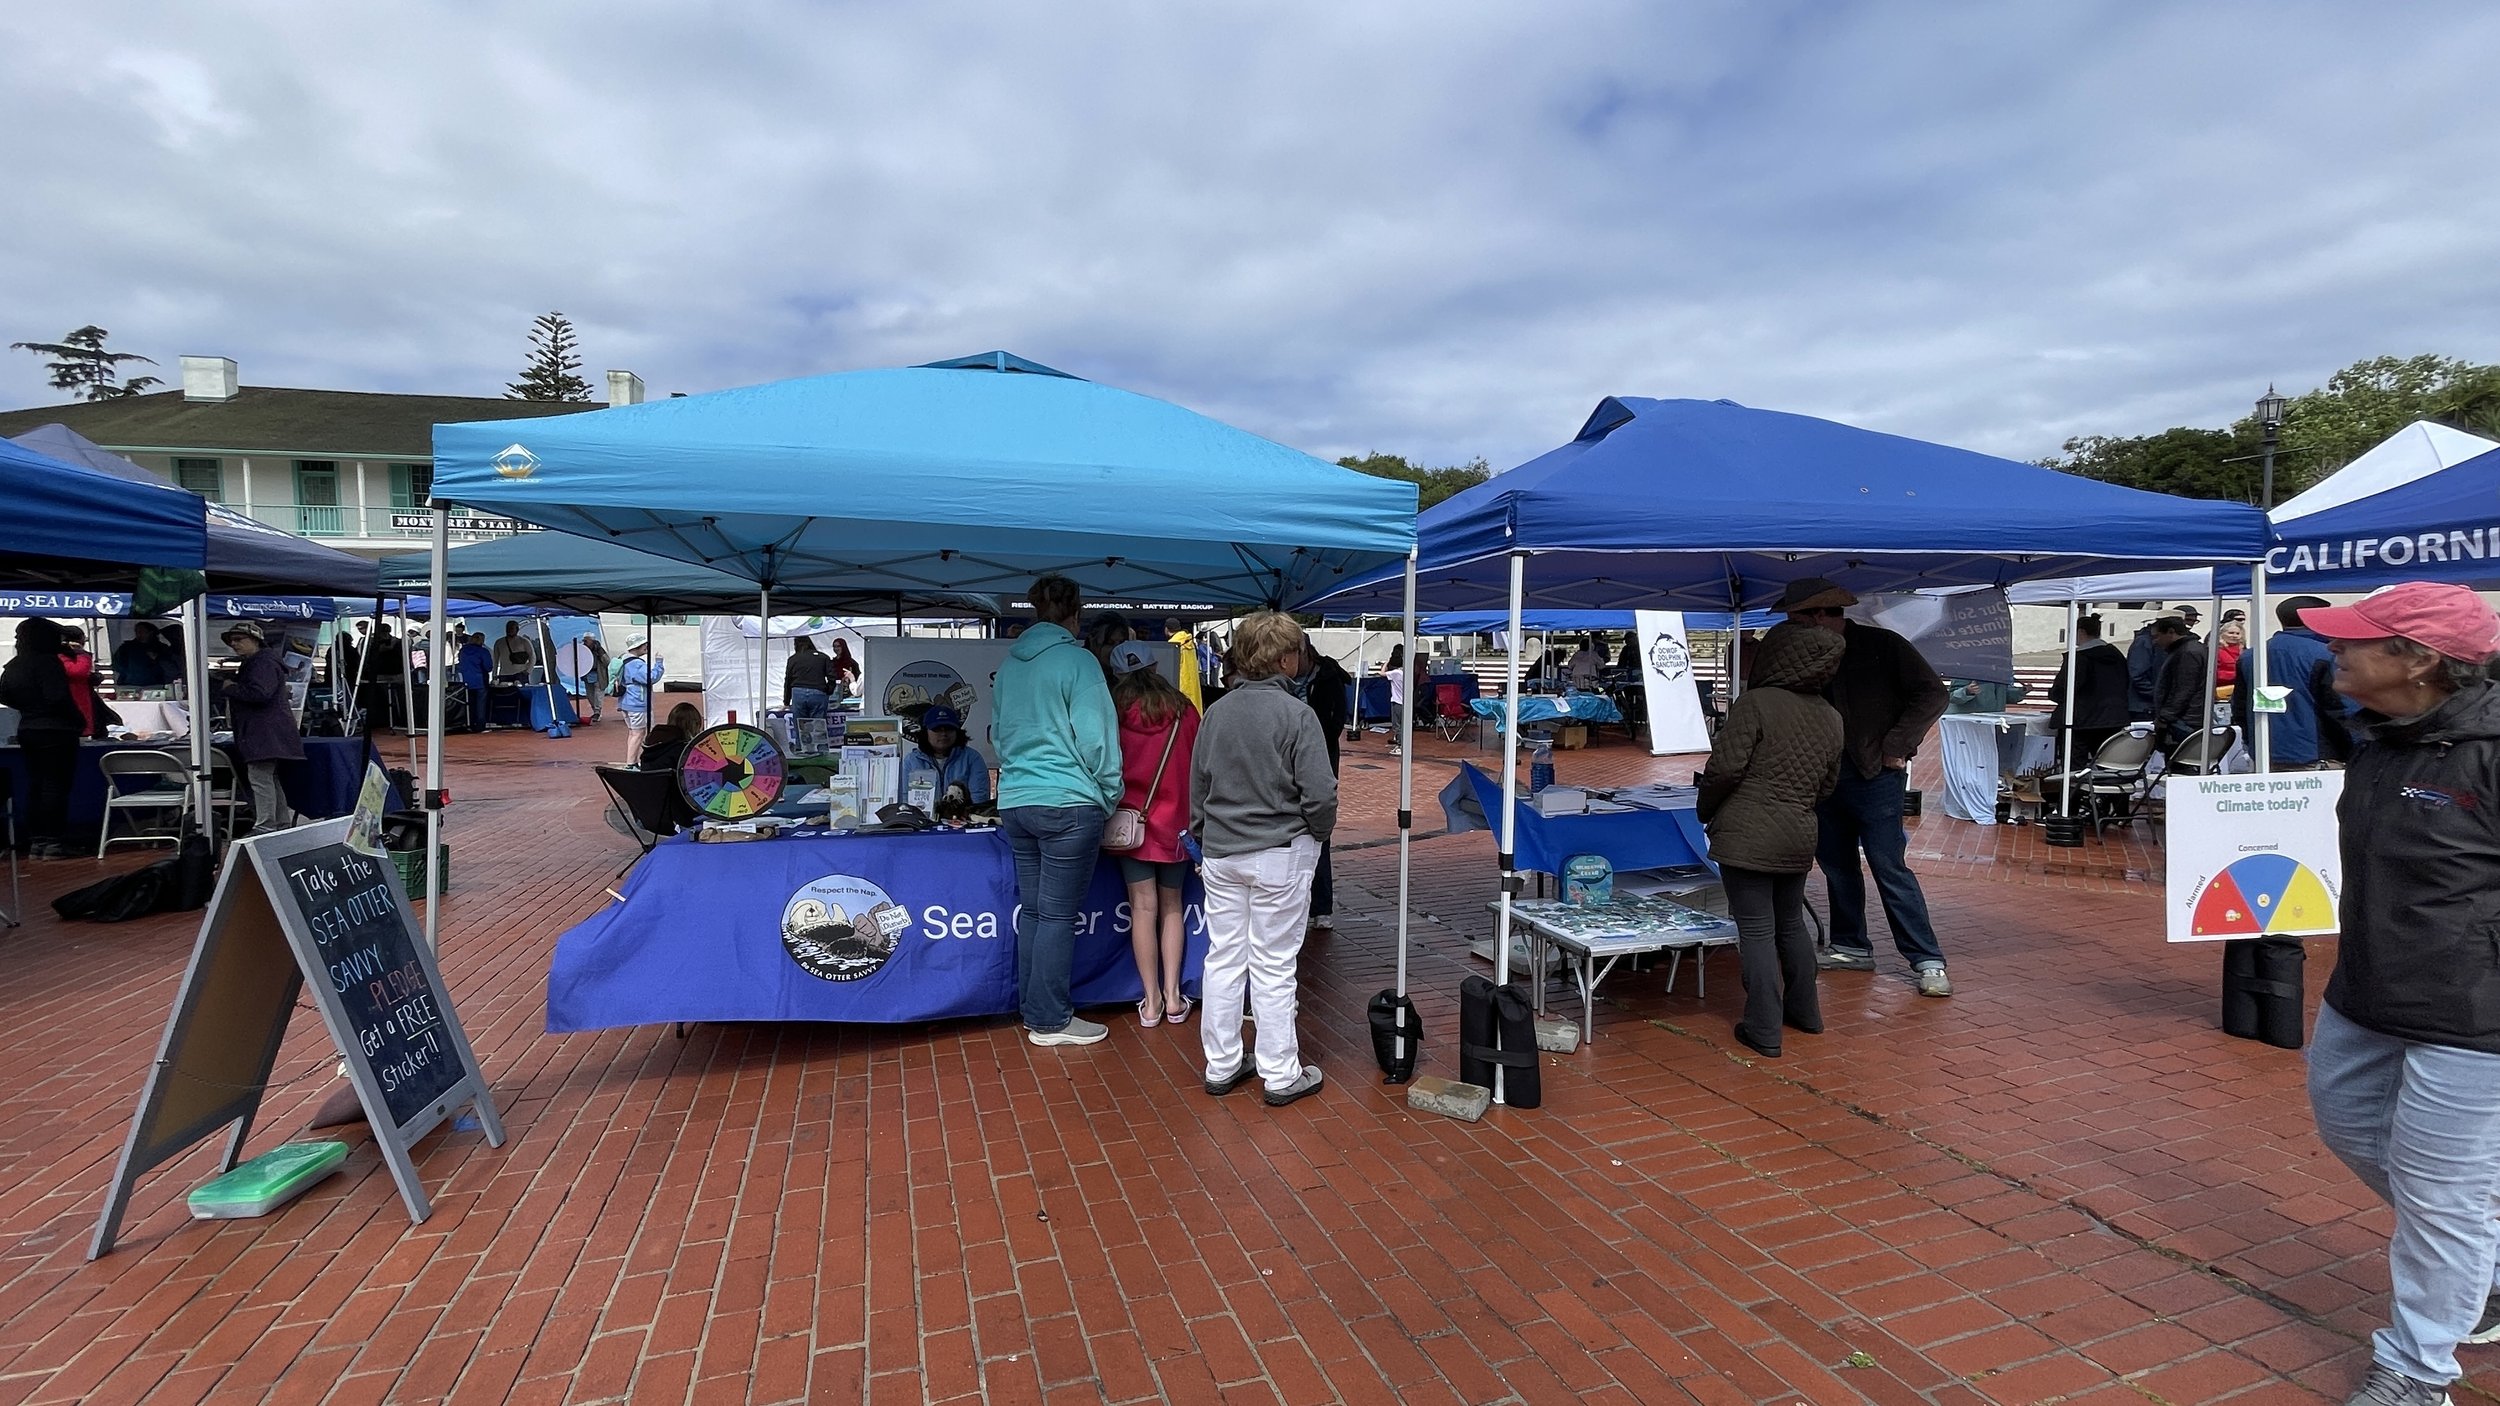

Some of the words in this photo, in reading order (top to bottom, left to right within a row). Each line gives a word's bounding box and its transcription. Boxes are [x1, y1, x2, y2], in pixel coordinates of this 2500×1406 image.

[396, 516, 474, 528] MONTREY
[24, 594, 59, 608] SEA
[63, 595, 94, 609] Lab
[1655, 660, 1686, 668] SANCTUARY
[2199, 780, 2242, 794] Where
[2244, 782, 2266, 793] are
[2268, 780, 2292, 794] you
[2294, 777, 2323, 790] with
[2216, 799, 2264, 813] Climate
[2267, 796, 2310, 812] today?
[2238, 843, 2279, 852] Concerned
[290, 864, 338, 901] Take
[341, 854, 373, 886] the
[2319, 868, 2340, 900] Cautious
[810, 886, 845, 895] Respect
[845, 886, 859, 894] the
[860, 888, 878, 897] Nap.
[2185, 875, 2206, 909] Alarmed
[311, 905, 351, 945] SEA
[348, 883, 396, 927] OTTER
[922, 904, 998, 940] Sea
[330, 943, 385, 994] SAVVY
[810, 967, 823, 978] SEA
[825, 972, 851, 981] OTTER
[853, 964, 878, 979] SAVVY
[369, 960, 427, 1012] PLEDGE
[360, 1023, 385, 1058] Get
[386, 1020, 397, 1035] a
[395, 994, 437, 1035] FREE
